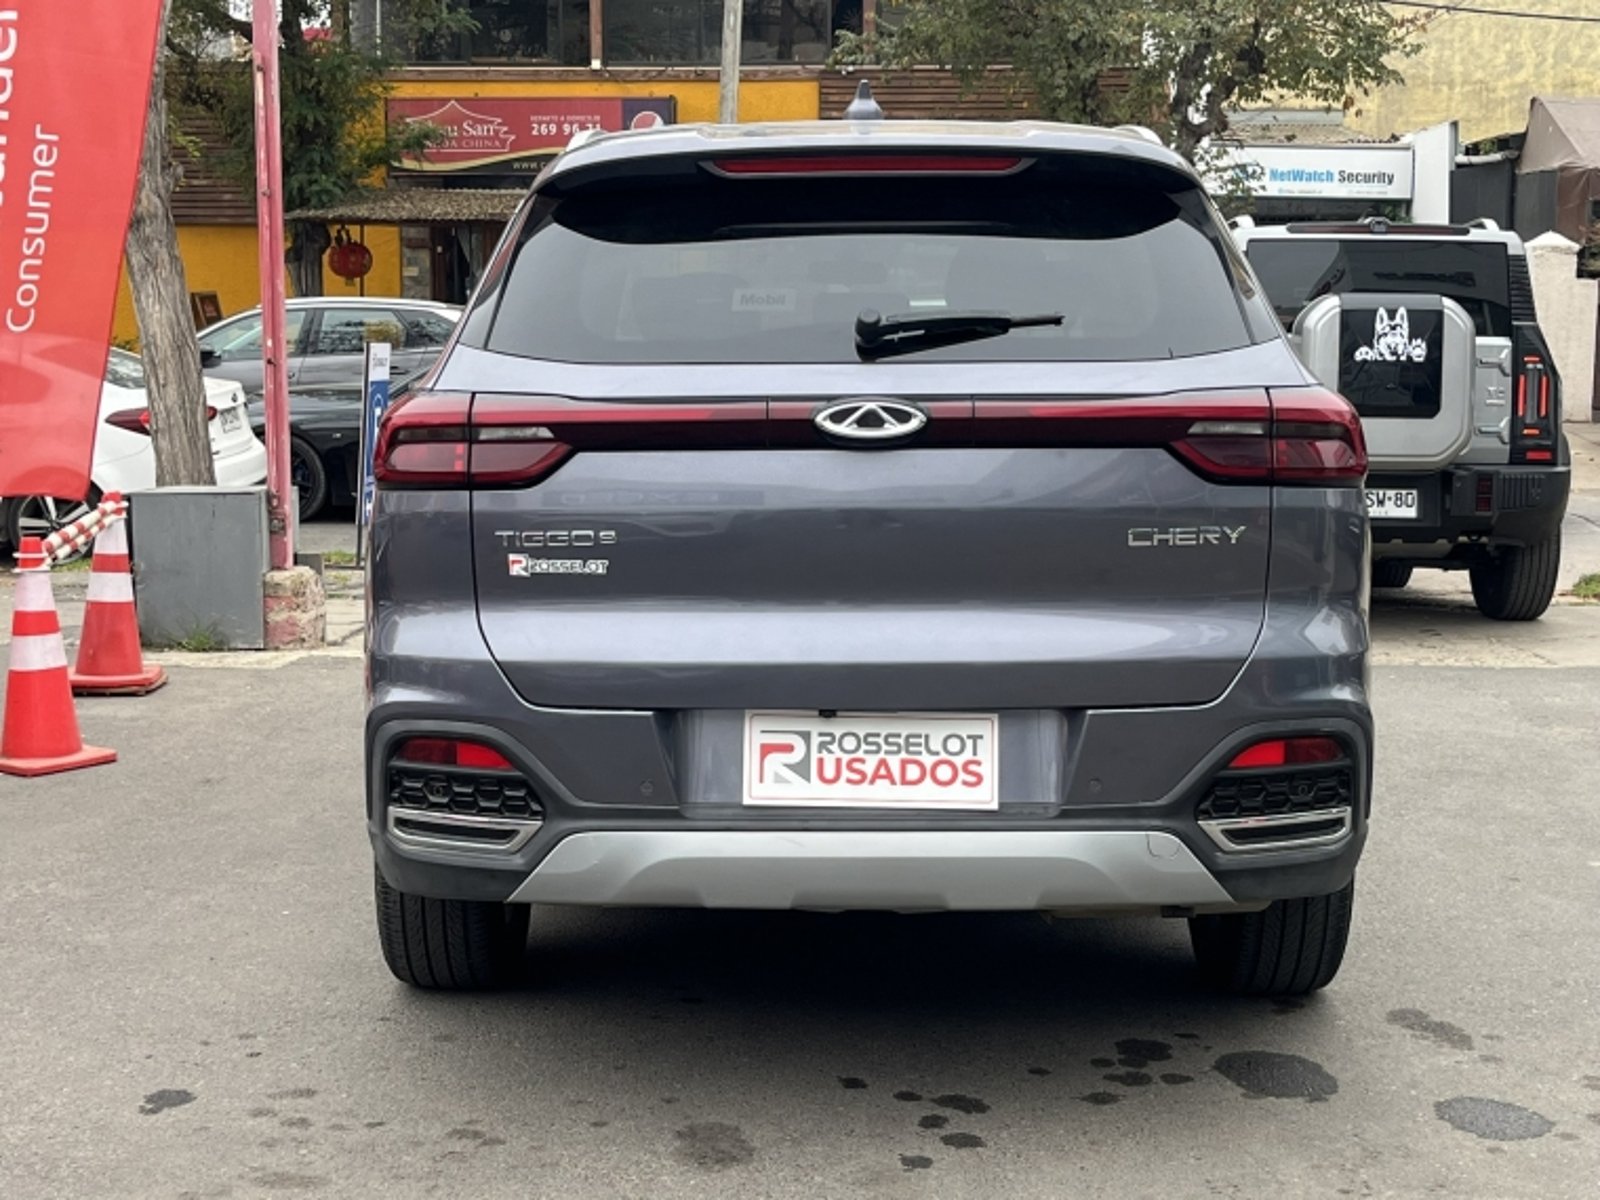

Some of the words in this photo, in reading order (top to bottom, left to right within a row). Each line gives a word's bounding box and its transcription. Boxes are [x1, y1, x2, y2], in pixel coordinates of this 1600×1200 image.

[531, 123, 557, 136] 269
[562, 123, 580, 136] 96
[1269, 168, 1334, 183] NetWatch
[1338, 169, 1395, 186] Security
[7, 124, 60, 333] Consumer
[739, 293, 787, 306] Mobil
[1127, 525, 1247, 546] CHERY
[528, 557, 609, 574] ROSSELOT
[817, 732, 984, 757] ROSSELOT
[816, 757, 985, 788] USADOS
